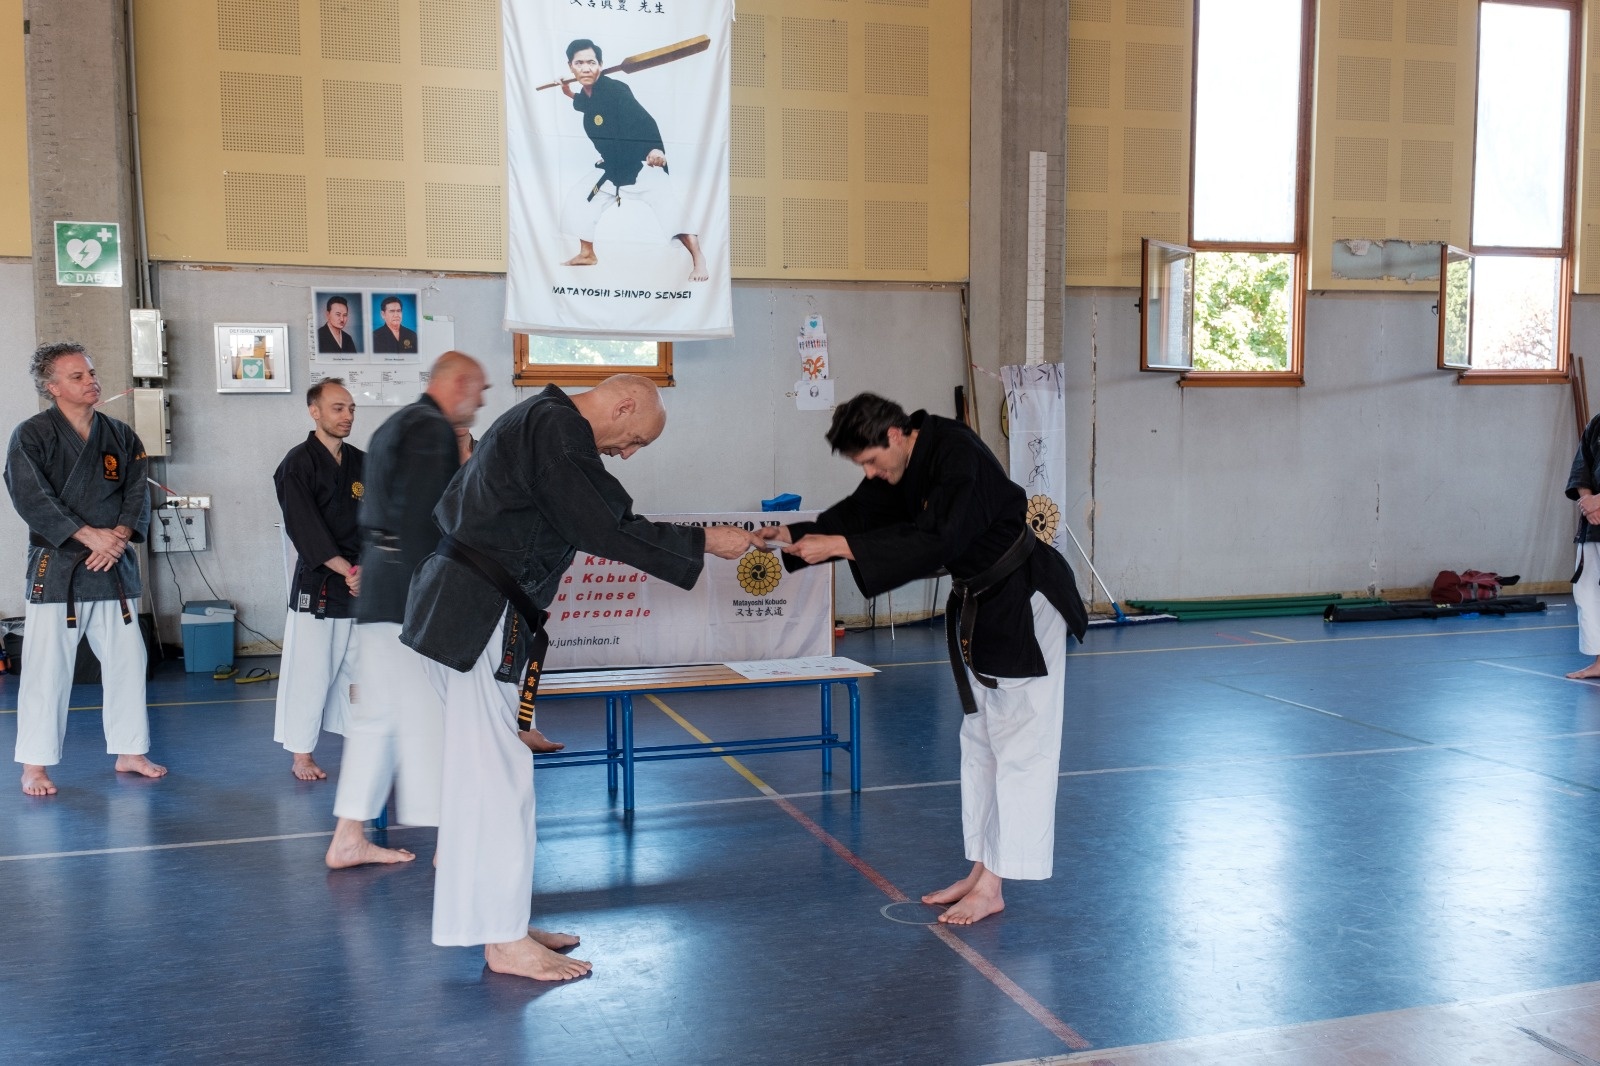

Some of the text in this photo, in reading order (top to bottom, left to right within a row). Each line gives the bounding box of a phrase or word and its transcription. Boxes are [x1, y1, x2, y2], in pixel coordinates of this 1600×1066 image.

[76, 273, 102, 283] DAE
[552, 286, 692, 299] MATAYOSHI SHINPO SENSEI
[576, 591, 636, 601] cinese
[732, 598, 787, 607] Matayoshi Kobudo
[561, 608, 651, 621] personale
